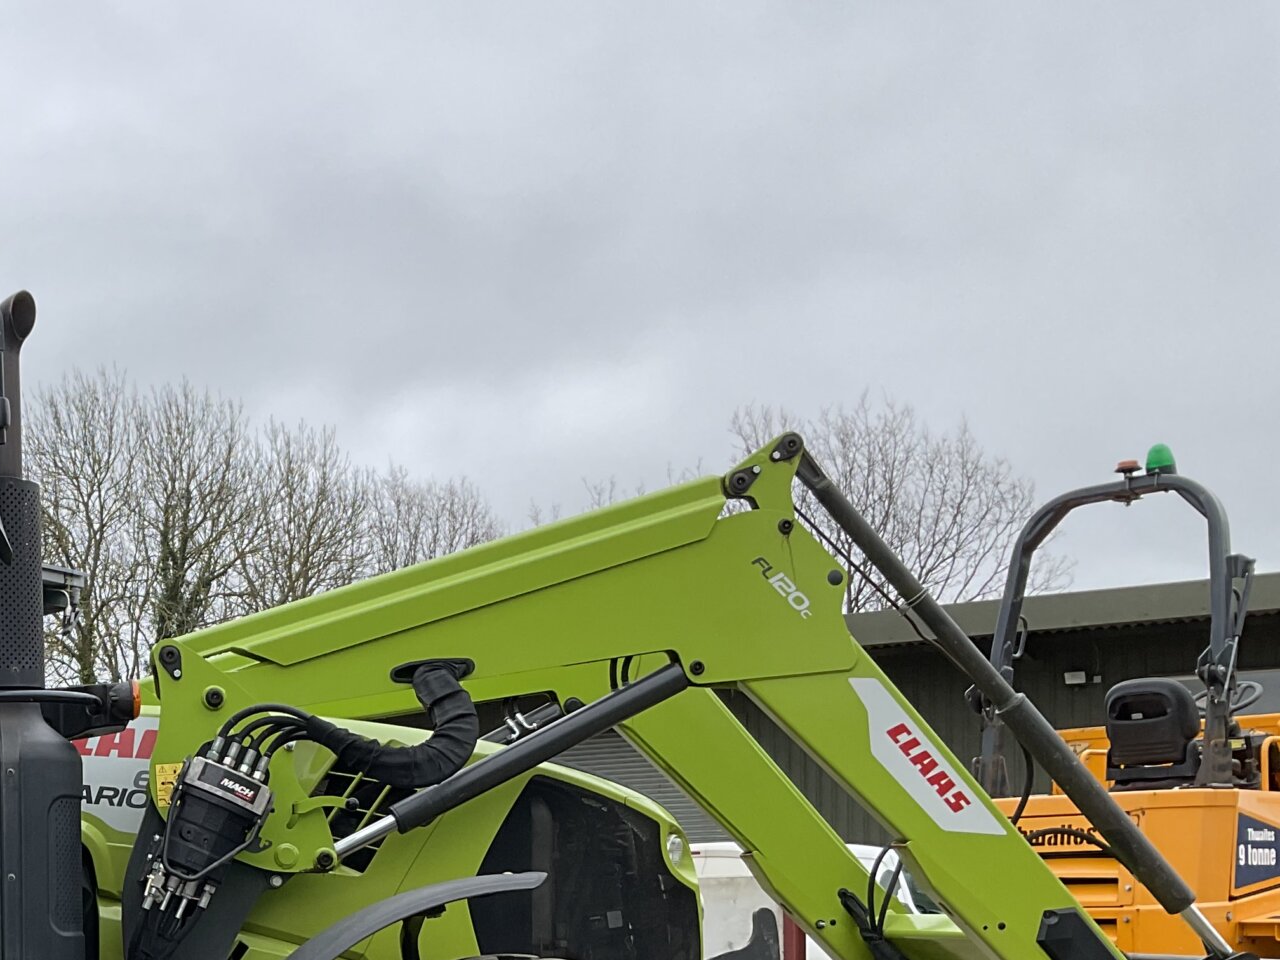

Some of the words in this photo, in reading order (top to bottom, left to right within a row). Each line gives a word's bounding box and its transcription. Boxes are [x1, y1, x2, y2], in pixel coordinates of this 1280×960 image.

[886, 722, 972, 814] CLAAS
[220, 777, 255, 798] MACH
[1238, 843, 1246, 866] 9
[1247, 843, 1277, 866] tonne
